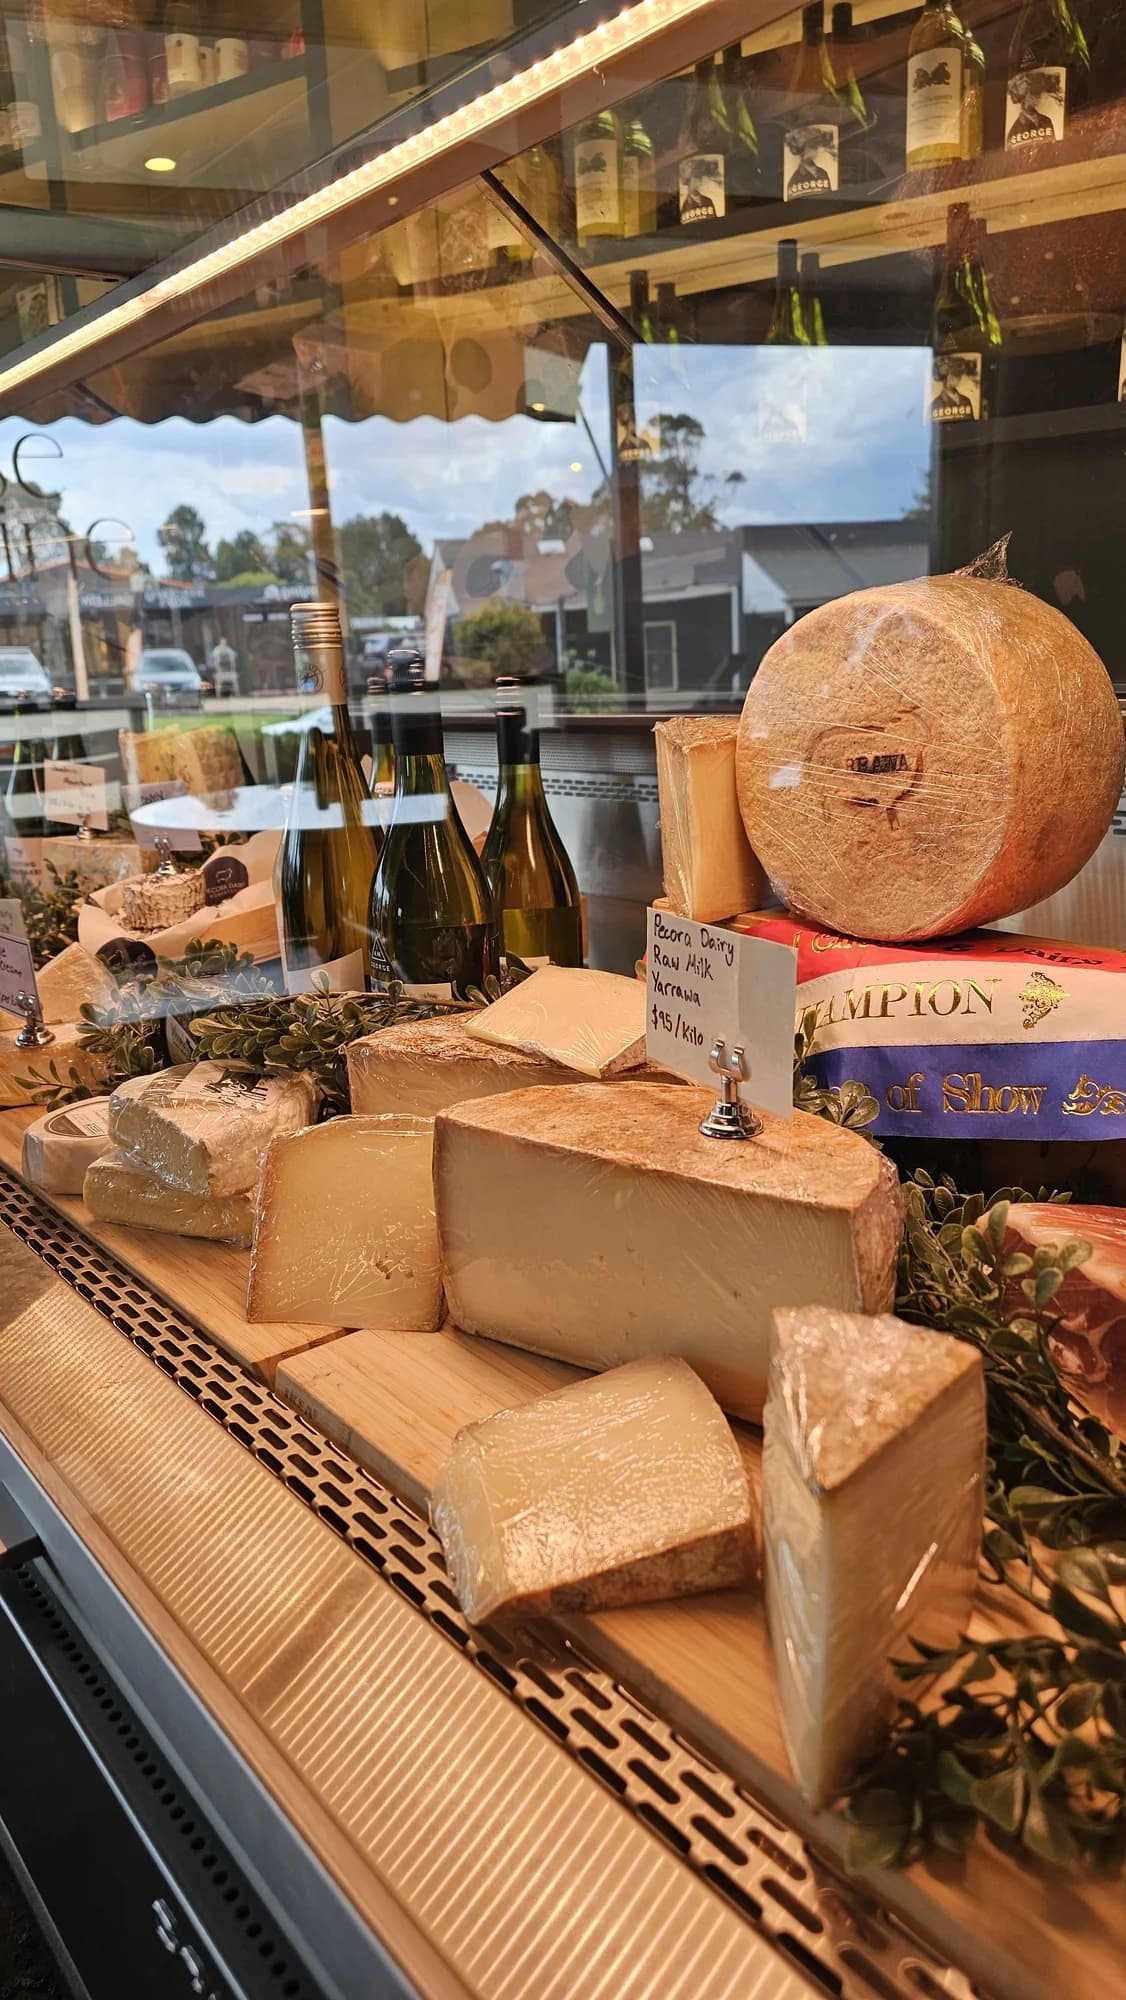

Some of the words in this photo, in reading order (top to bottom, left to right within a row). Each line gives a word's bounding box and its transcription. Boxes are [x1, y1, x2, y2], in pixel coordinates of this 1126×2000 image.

[1010, 127, 1053, 144] GEORGE
[791, 179, 829, 193] GEORGE
[932, 405, 971, 417] GEORGE
[654, 913, 692, 948] Pecora
[700, 927, 734, 967] Dairy
[653, 944, 680, 971] Raw
[685, 953, 714, 981] Milk
[997, 947, 1103, 966] airy
[652, 970, 701, 1007] Yarrawa
[886, 1071, 926, 1113] of
[943, 1071, 1048, 1116] Show
